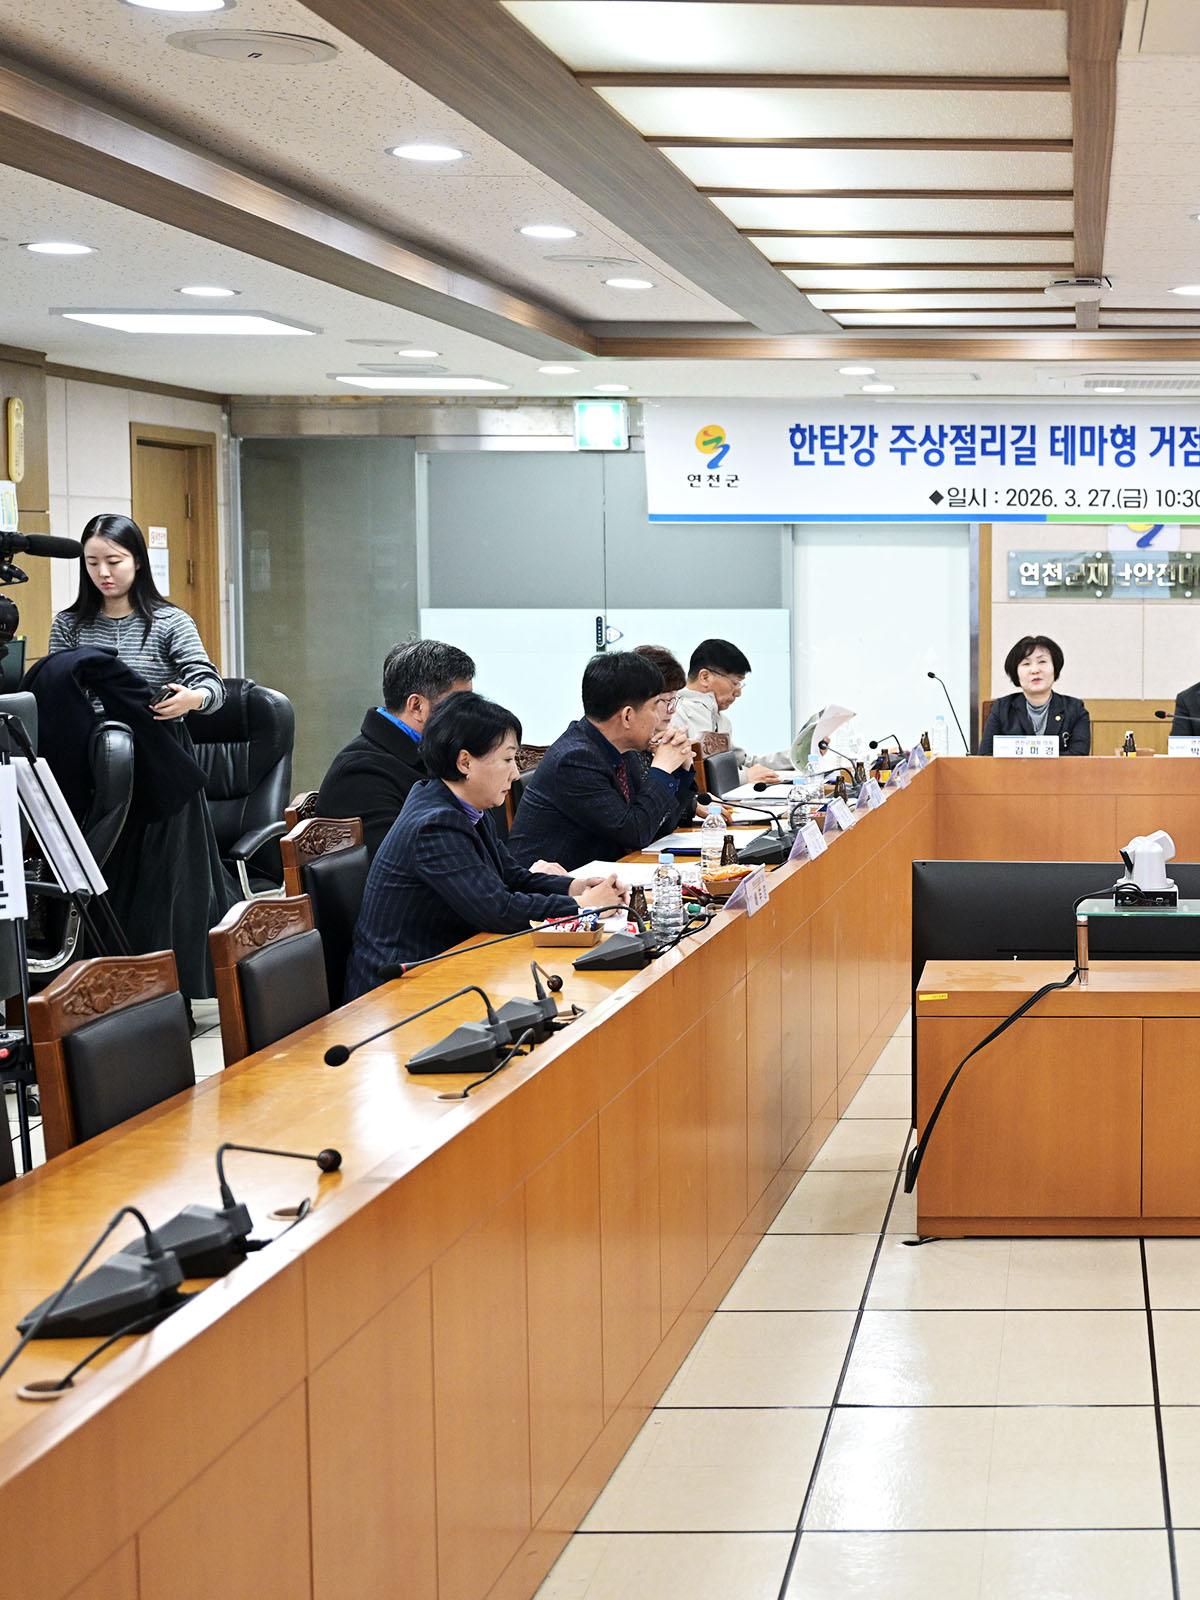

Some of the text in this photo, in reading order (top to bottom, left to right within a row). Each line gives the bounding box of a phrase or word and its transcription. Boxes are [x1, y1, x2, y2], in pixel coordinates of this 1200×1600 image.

[788, 424, 879, 468] 한탄강
[889, 424, 1037, 468] 주상절리길
[1049, 424, 1136, 468] 테마형
[687, 474, 740, 488] 연천군
[947, 487, 987, 508] 일시
[1005, 488, 1058, 508] 2026.
[1064, 488, 1082, 508] 3.
[1087, 487, 1149, 509] 27.(금)
